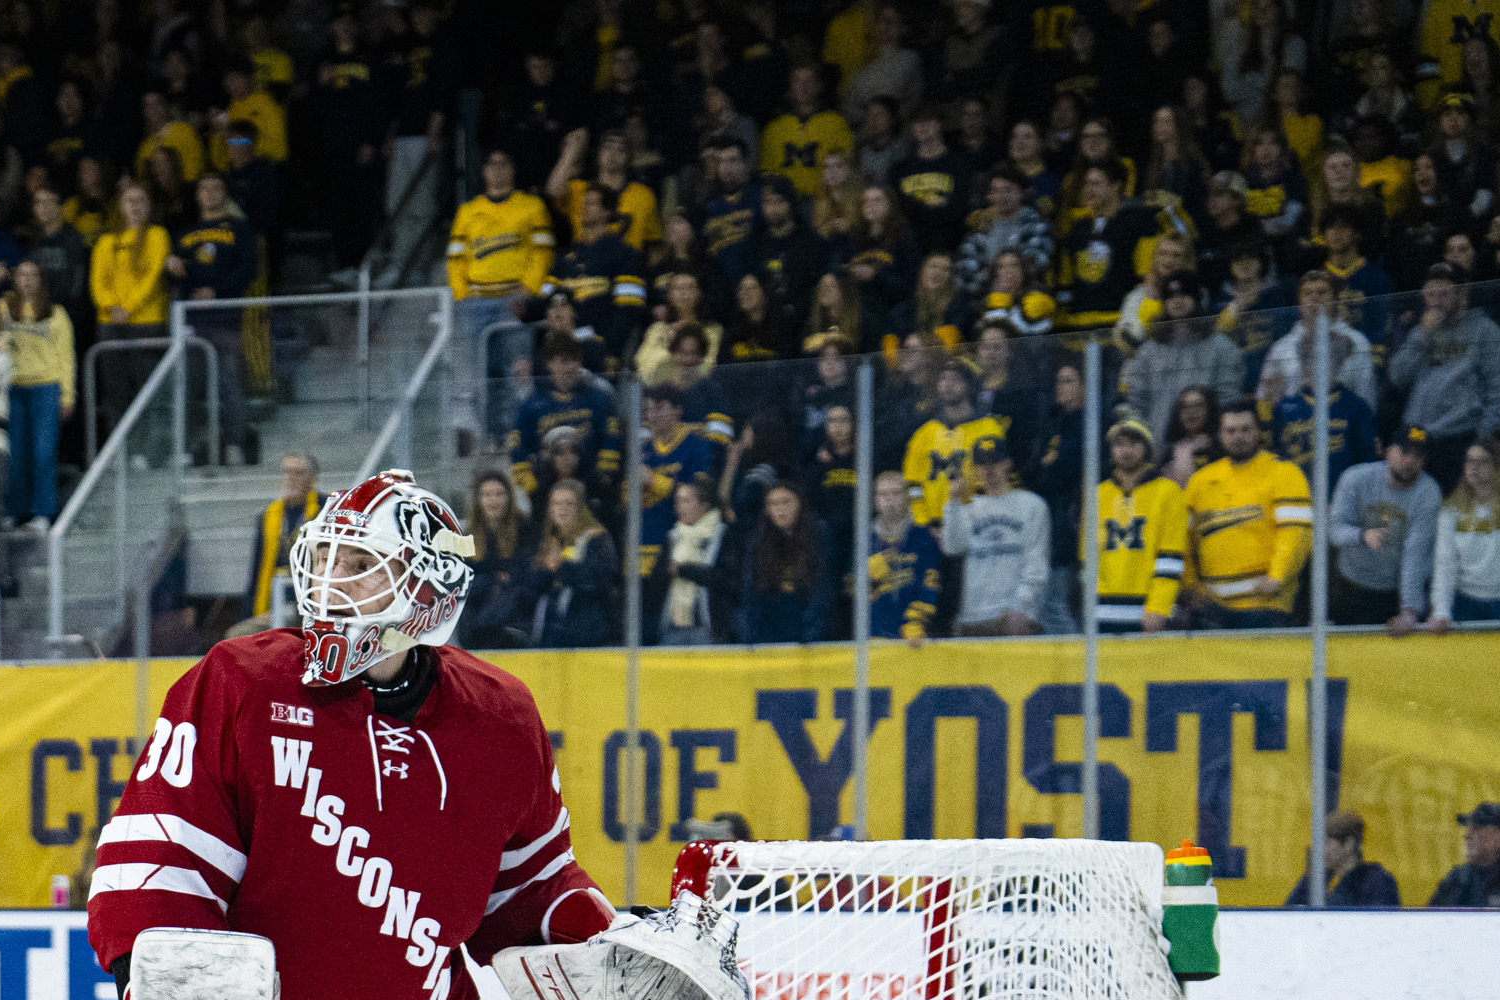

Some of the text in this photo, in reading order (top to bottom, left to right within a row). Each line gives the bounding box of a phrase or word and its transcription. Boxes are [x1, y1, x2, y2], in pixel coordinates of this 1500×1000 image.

[785, 141, 818, 167] M
[929, 449, 967, 480] M
[1104, 516, 1147, 551] M
[137, 717, 197, 788] 30
[602, 728, 737, 845] OF
